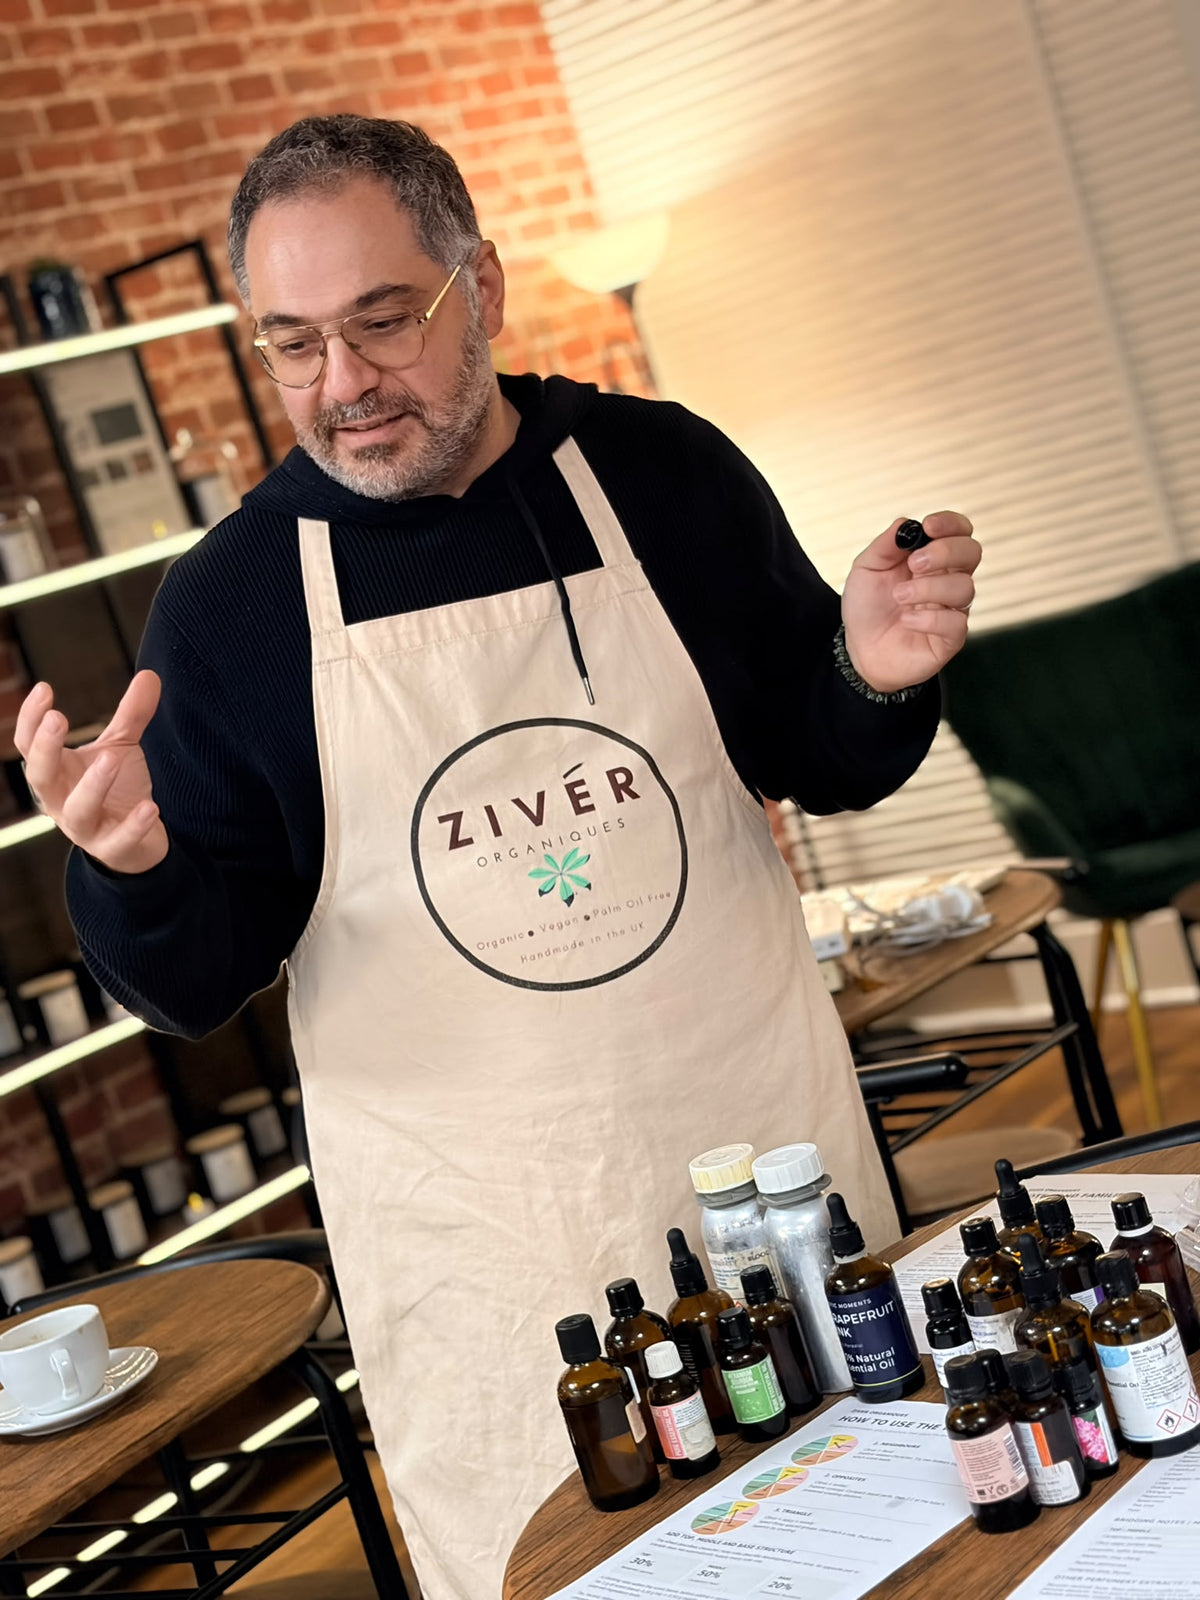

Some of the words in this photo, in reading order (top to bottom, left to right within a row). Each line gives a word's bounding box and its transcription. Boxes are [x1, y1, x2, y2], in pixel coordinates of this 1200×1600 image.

[438, 762, 640, 850] ZIVÉR
[477, 818, 626, 868] ORGANIQUES
[477, 931, 524, 950] Organic
[540, 917, 579, 933] Vegan
[594, 905, 622, 920] Palm
[626, 896, 643, 908] Oil
[648, 892, 671, 903] Free
[521, 941, 584, 964] Handmade
[591, 935, 602, 945] in
[607, 927, 626, 940] the
[631, 921, 645, 933] UK
[838, 1298, 872, 1308] MOMENTS
[856, 1347, 895, 1364] Natural
[879, 1360, 895, 1369] Oil
[891, 1420, 914, 1428] USE
[696, 1536, 722, 1546] MIDDLE
[722, 1540, 738, 1548] AND
[737, 1542, 755, 1550] BASE
[757, 1544, 796, 1555] STRUCTURE
[629, 1557, 653, 1567] 30%
[697, 1570, 721, 1578] 50%
[768, 1581, 792, 1590] 20%
